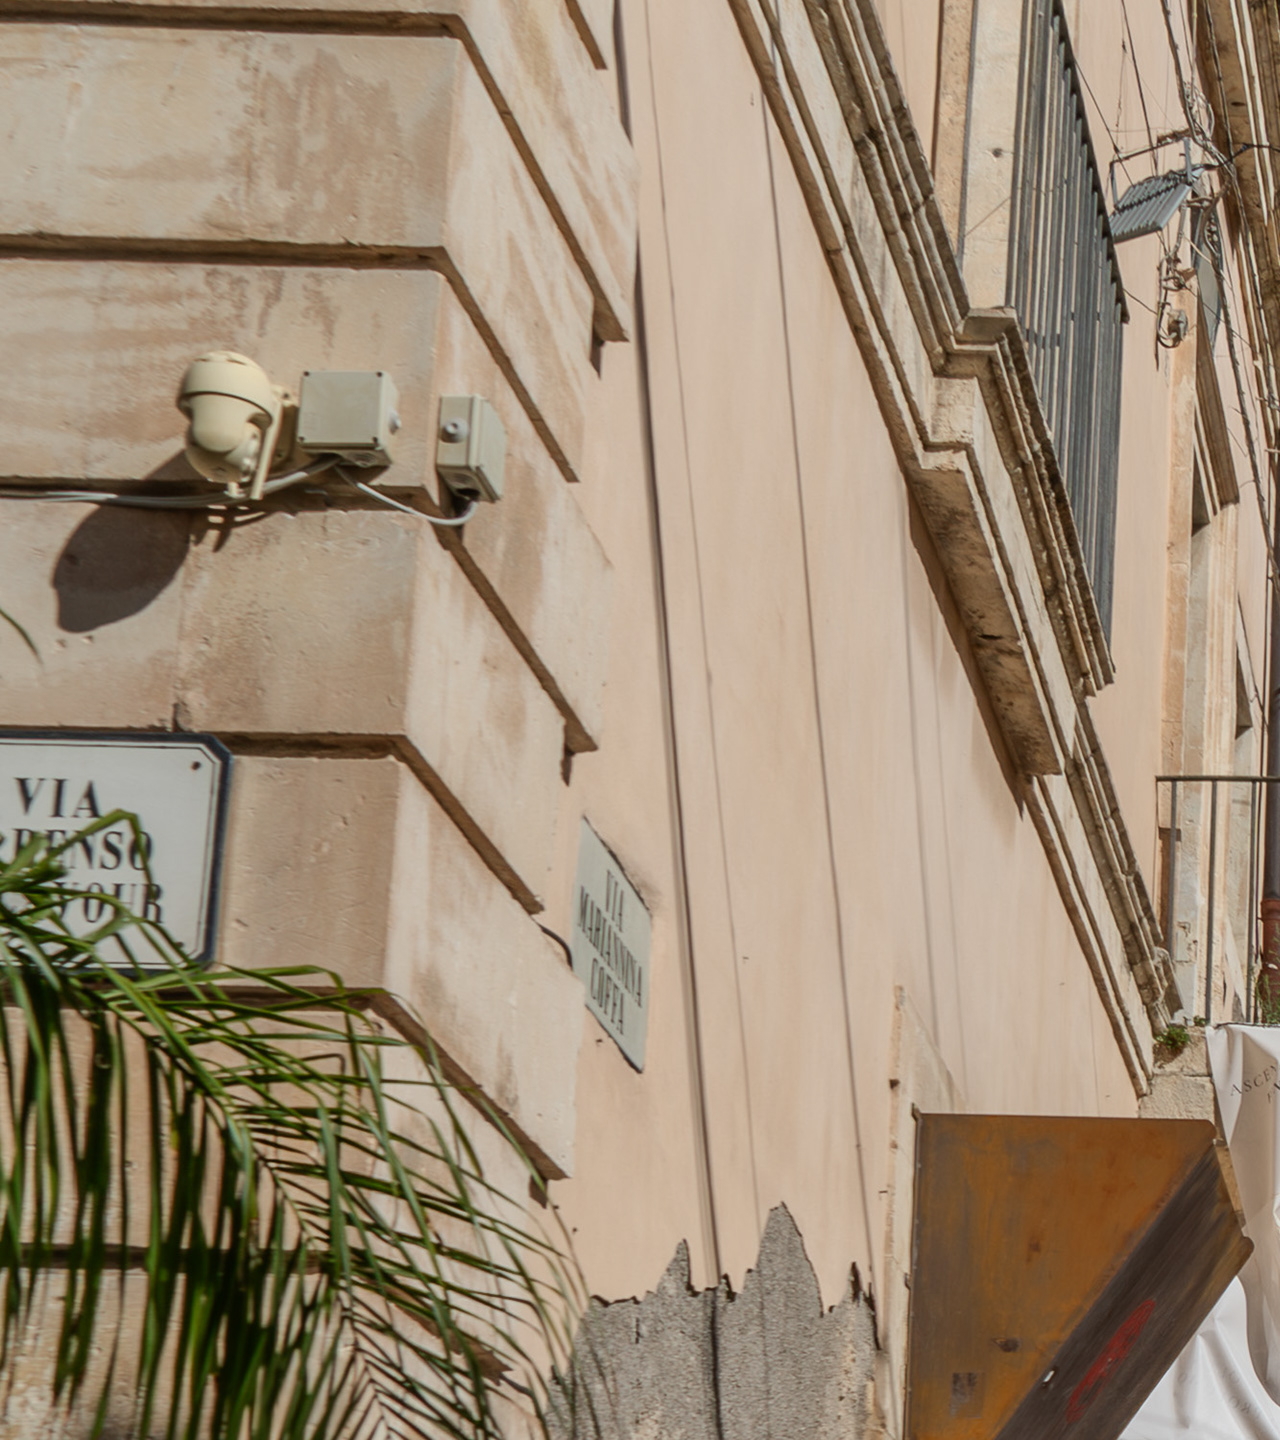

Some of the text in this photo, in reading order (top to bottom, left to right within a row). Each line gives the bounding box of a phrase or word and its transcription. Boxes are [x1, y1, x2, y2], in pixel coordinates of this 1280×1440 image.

[14, 777, 102, 818] VIA
[605, 869, 625, 933] VIA
[578, 885, 642, 1008] MARIANNINA
[589, 957, 625, 1035] COFFA
